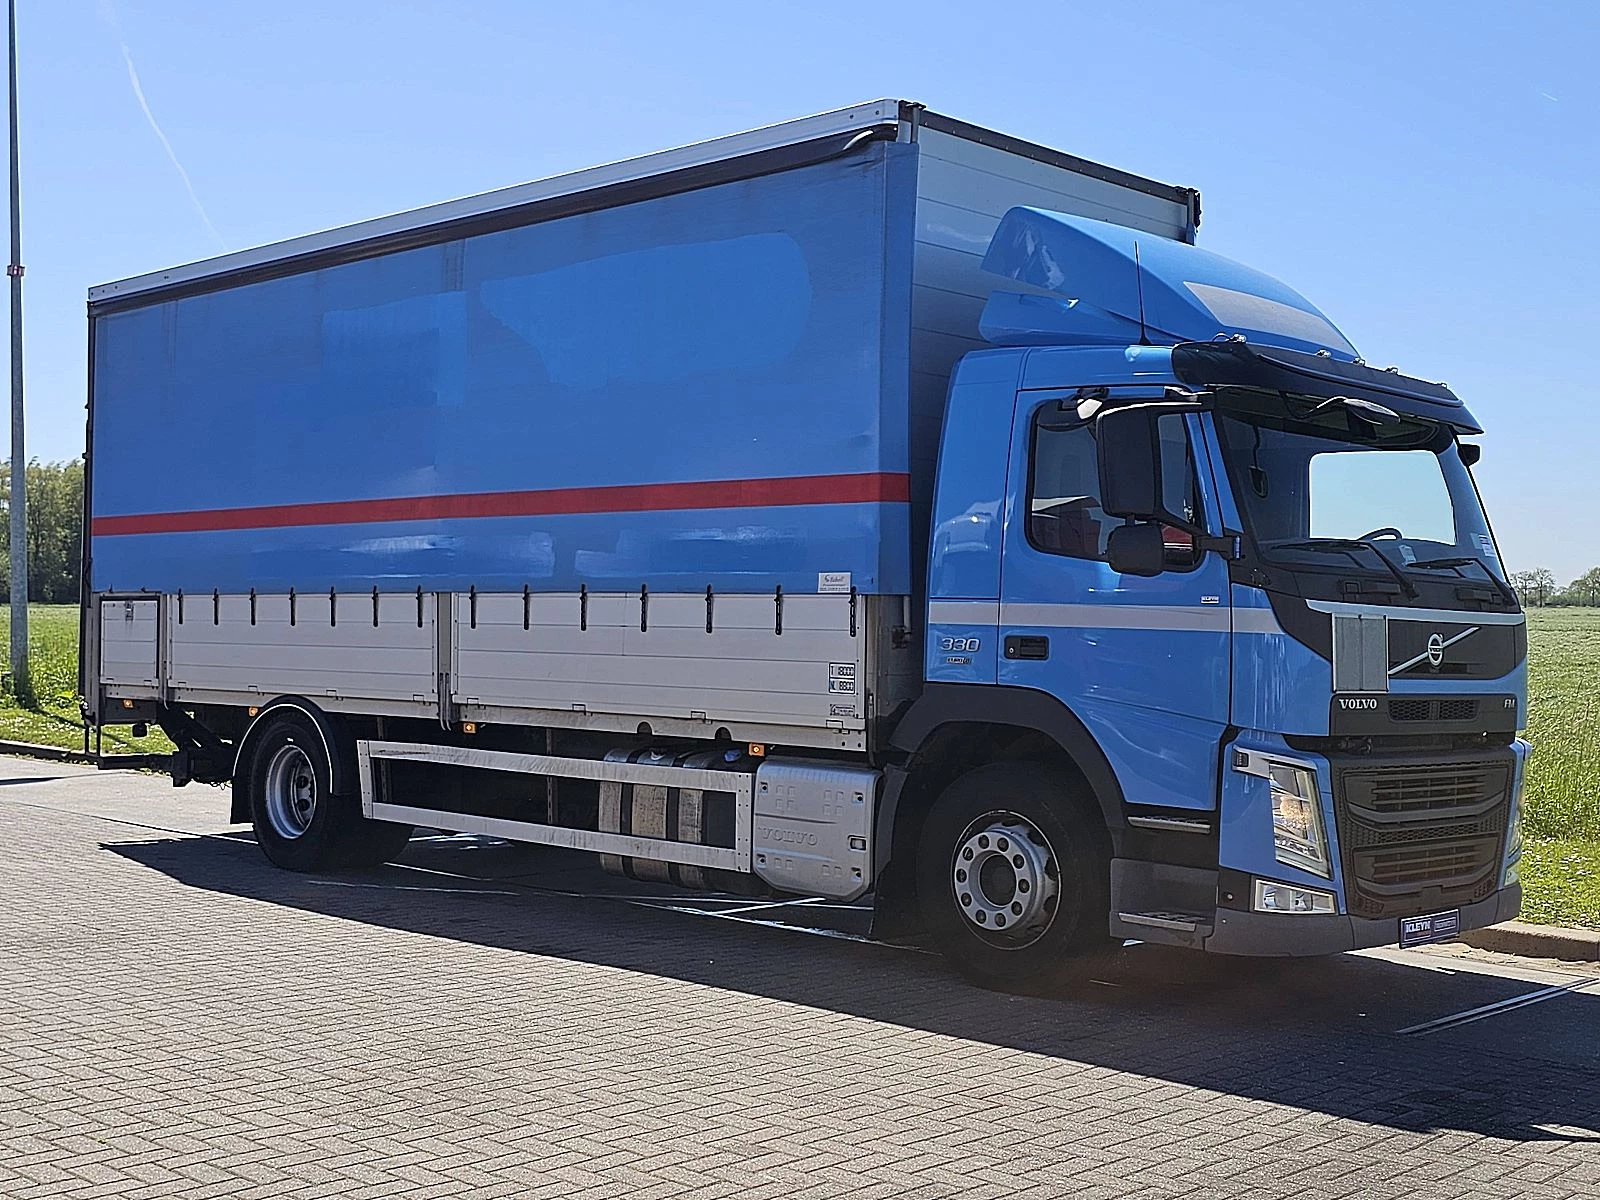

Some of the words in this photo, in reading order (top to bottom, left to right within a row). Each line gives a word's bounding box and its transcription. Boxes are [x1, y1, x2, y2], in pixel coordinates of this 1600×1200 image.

[940, 637, 980, 652] 330
[839, 680, 854, 691] 8800
[1338, 698, 1378, 709] VOLVO
[757, 826, 818, 846] VOLVO
[1404, 920, 1431, 933] KLEYN
